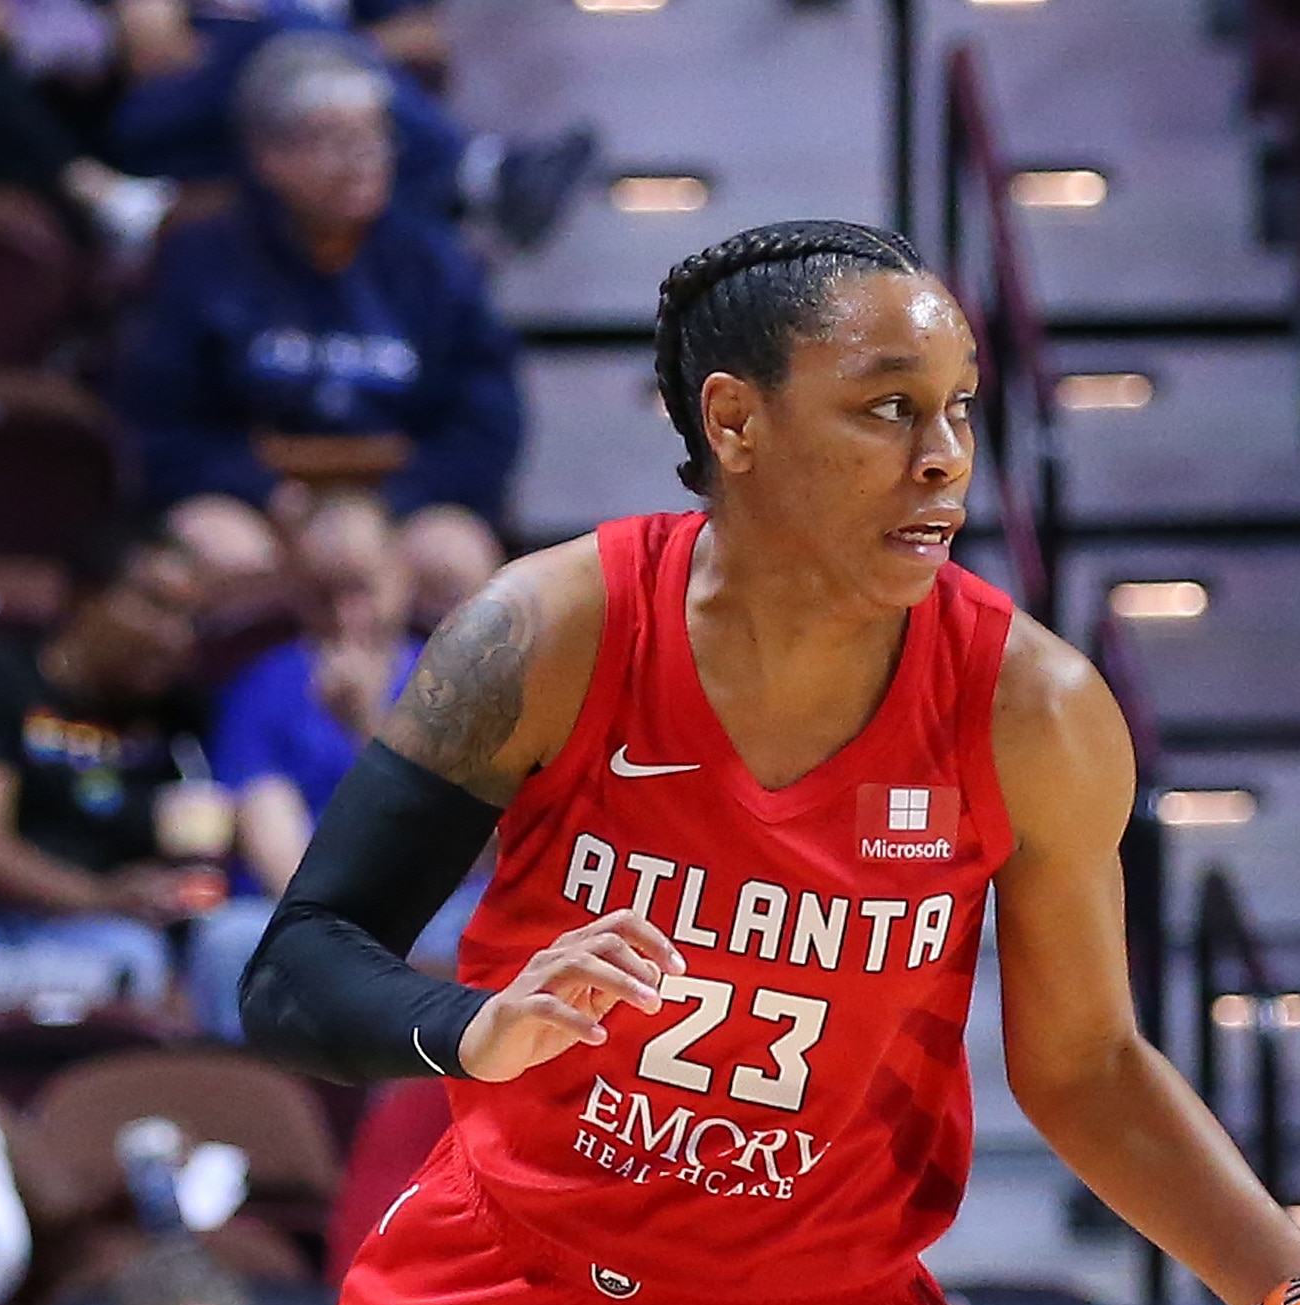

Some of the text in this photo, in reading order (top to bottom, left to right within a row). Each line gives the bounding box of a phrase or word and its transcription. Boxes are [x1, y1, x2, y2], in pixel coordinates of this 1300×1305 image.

[861, 837, 952, 859] Microsoft
[563, 833, 954, 973] ATLANTA
[638, 973, 829, 1111] 23
[572, 1129, 795, 1199] HEALHCARE
